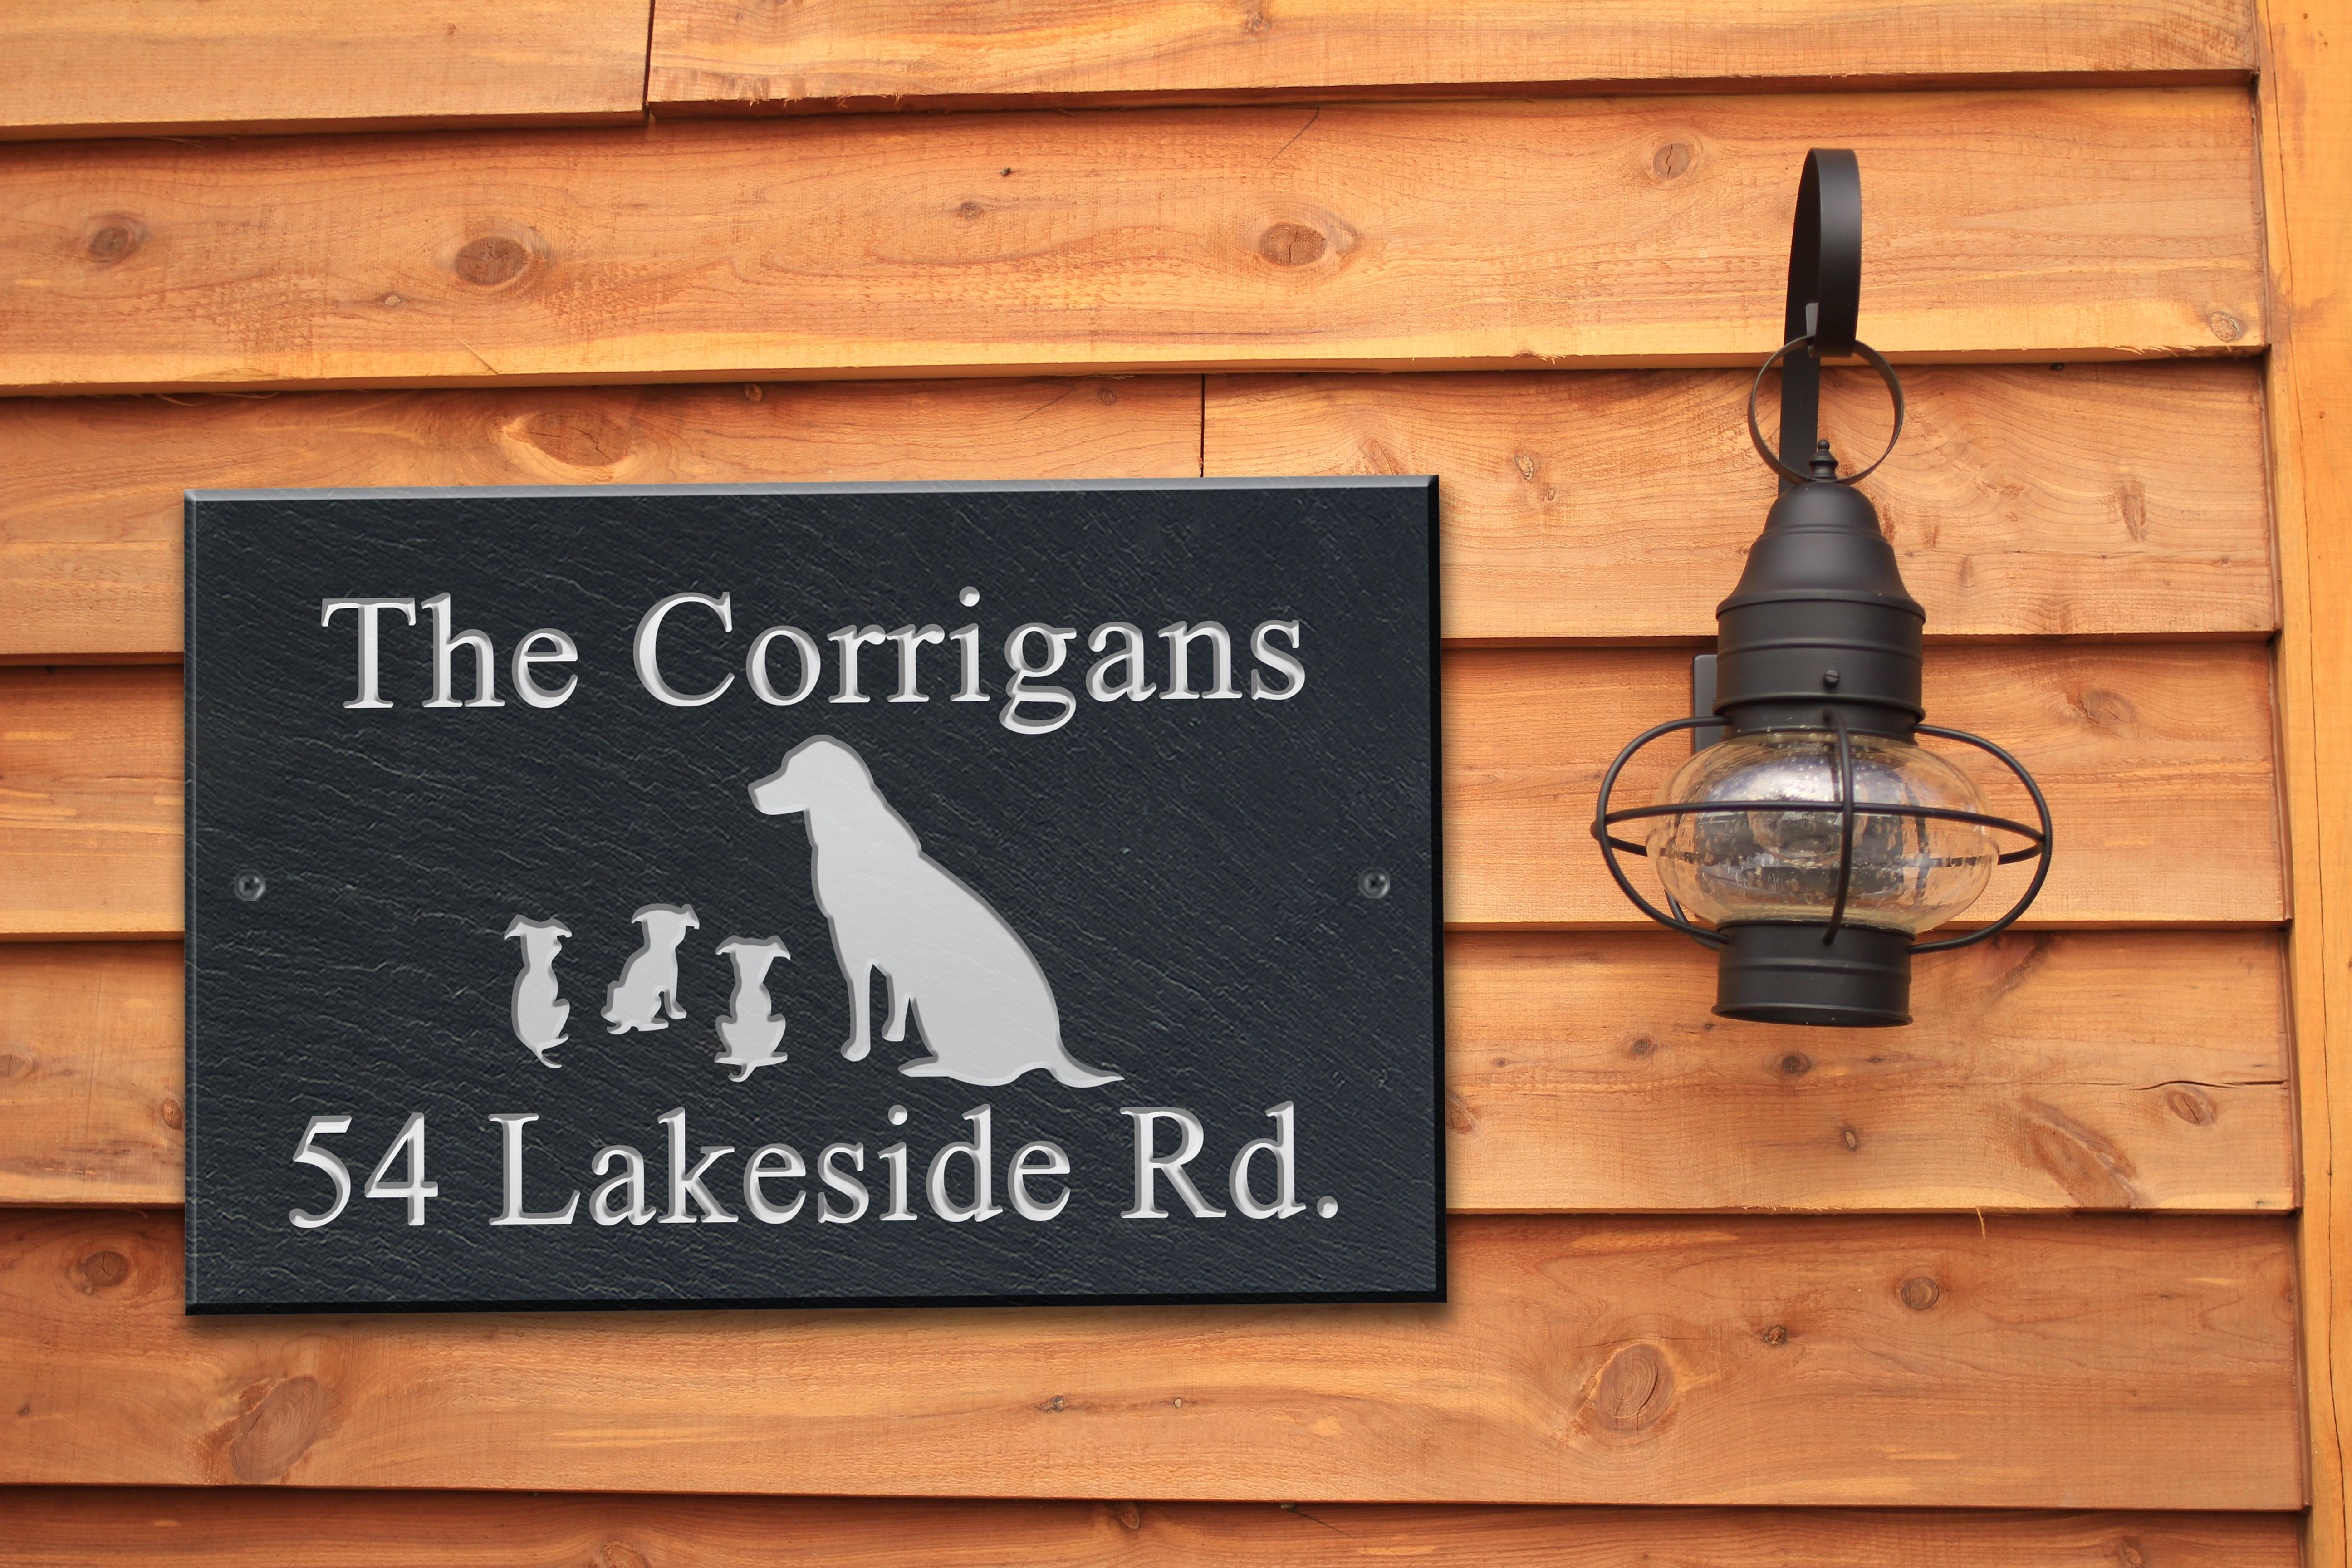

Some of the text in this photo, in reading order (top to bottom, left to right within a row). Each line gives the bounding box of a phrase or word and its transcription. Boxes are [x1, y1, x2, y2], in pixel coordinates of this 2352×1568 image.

[321, 586, 1306, 735] The Corrigans
[288, 1100, 1339, 1229] 54 Lakeside Rd.
